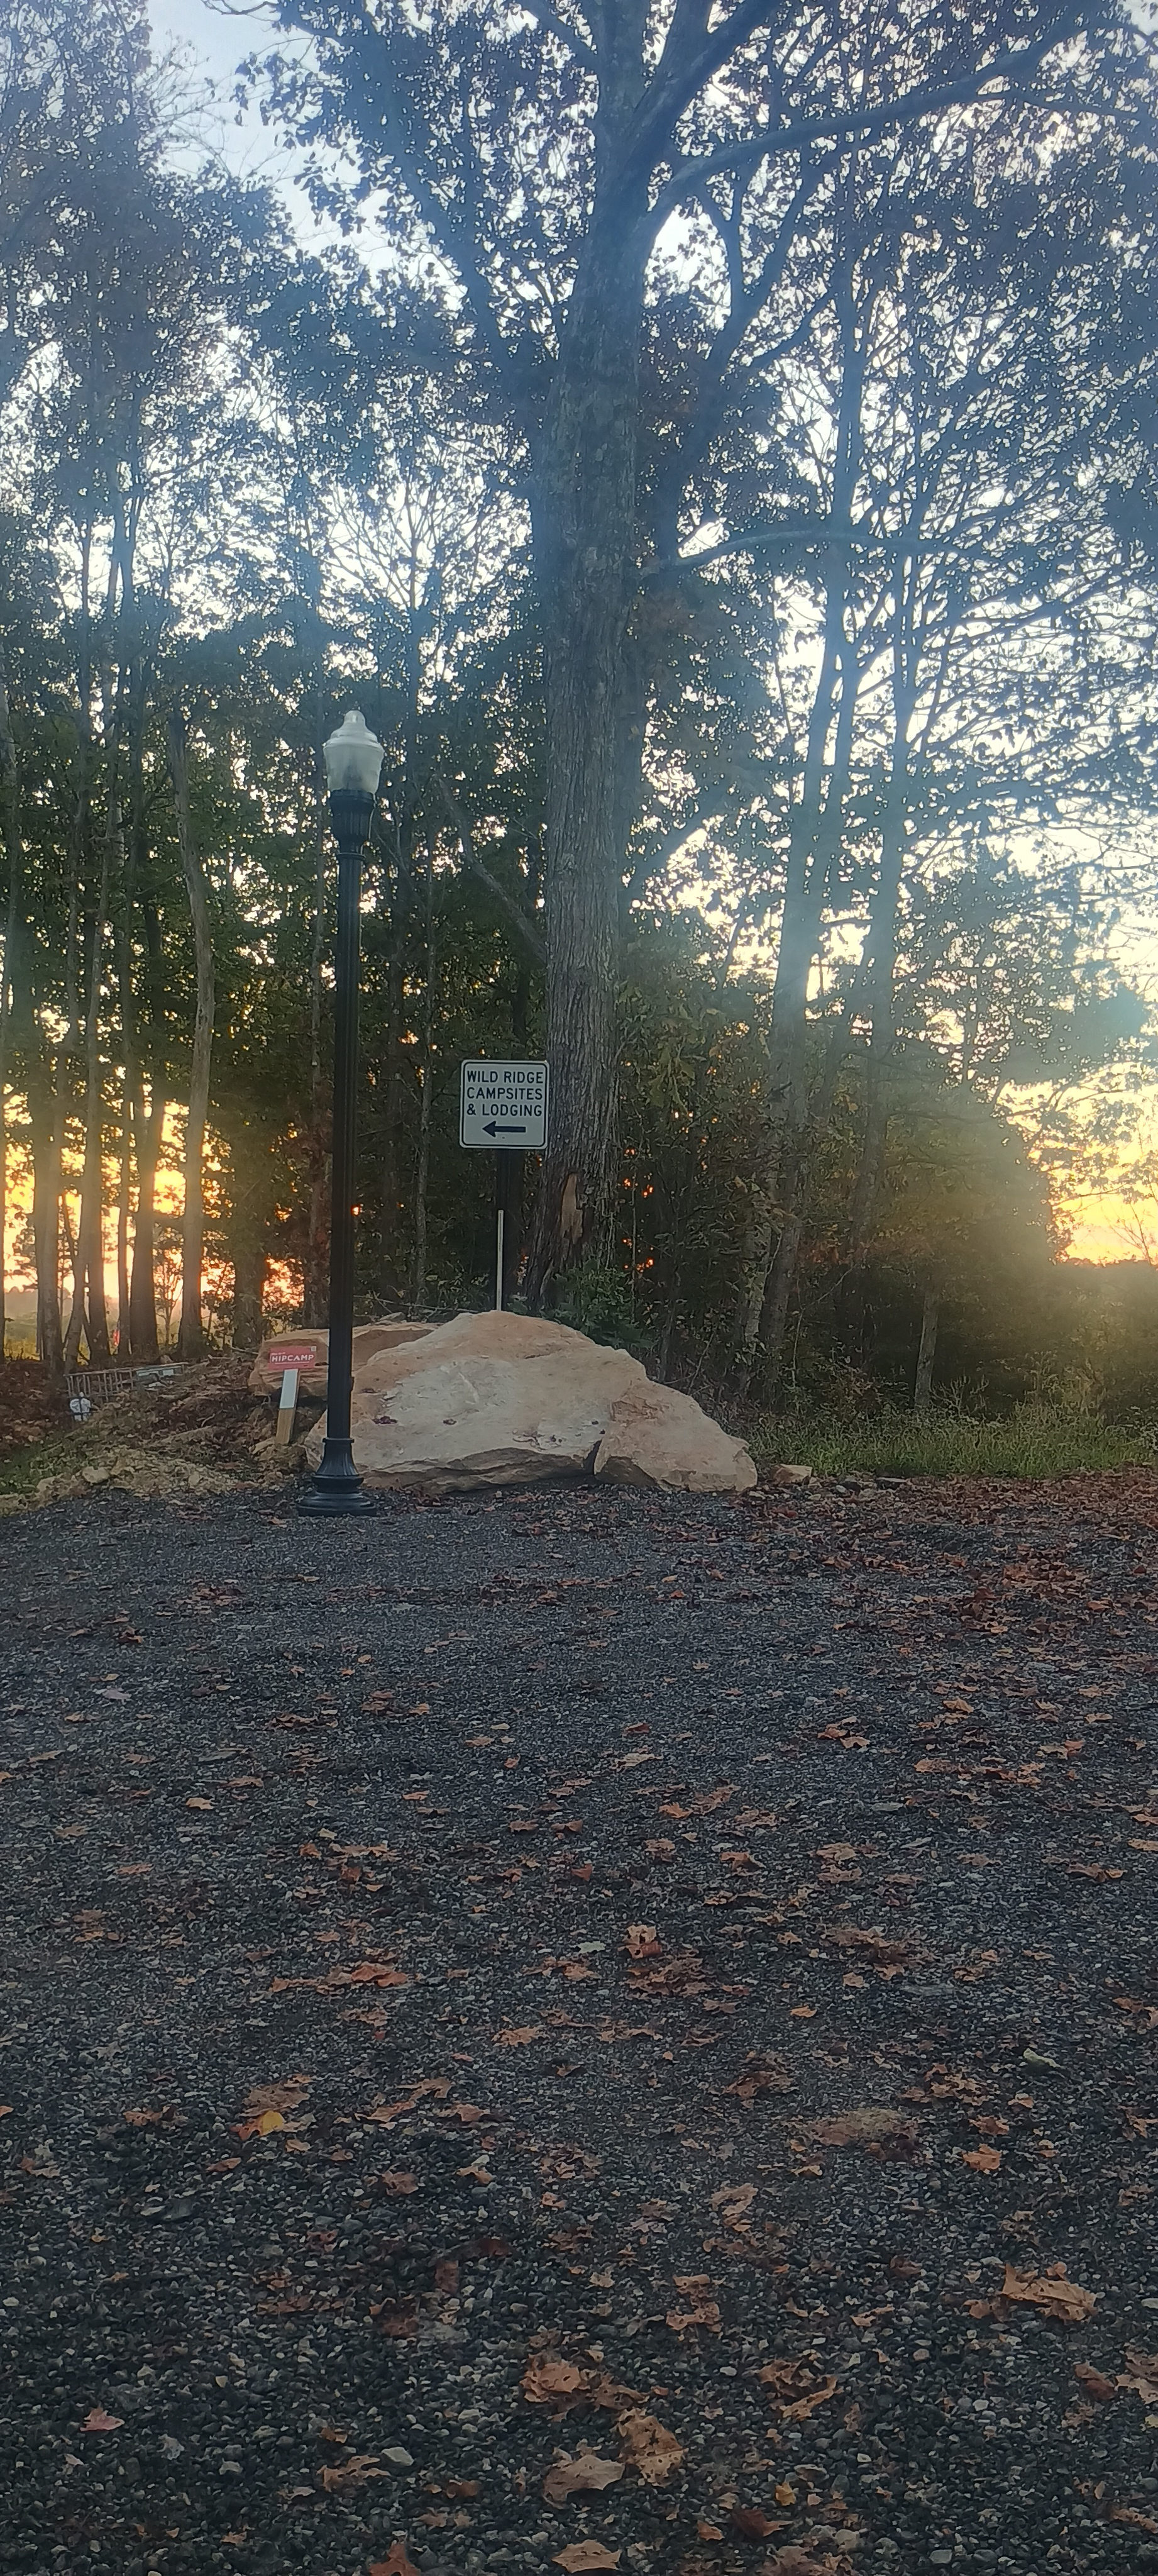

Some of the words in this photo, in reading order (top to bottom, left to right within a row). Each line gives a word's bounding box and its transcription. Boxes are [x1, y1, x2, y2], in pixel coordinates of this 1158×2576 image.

[467, 1070, 498, 1082] WILD
[504, 1071, 543, 1084] RIDGE
[467, 1087, 543, 1100] CAMPSITES
[466, 1103, 476, 1116] &
[482, 1104, 542, 1116] LODGING
[272, 1354, 314, 1362] HIPCAMP
